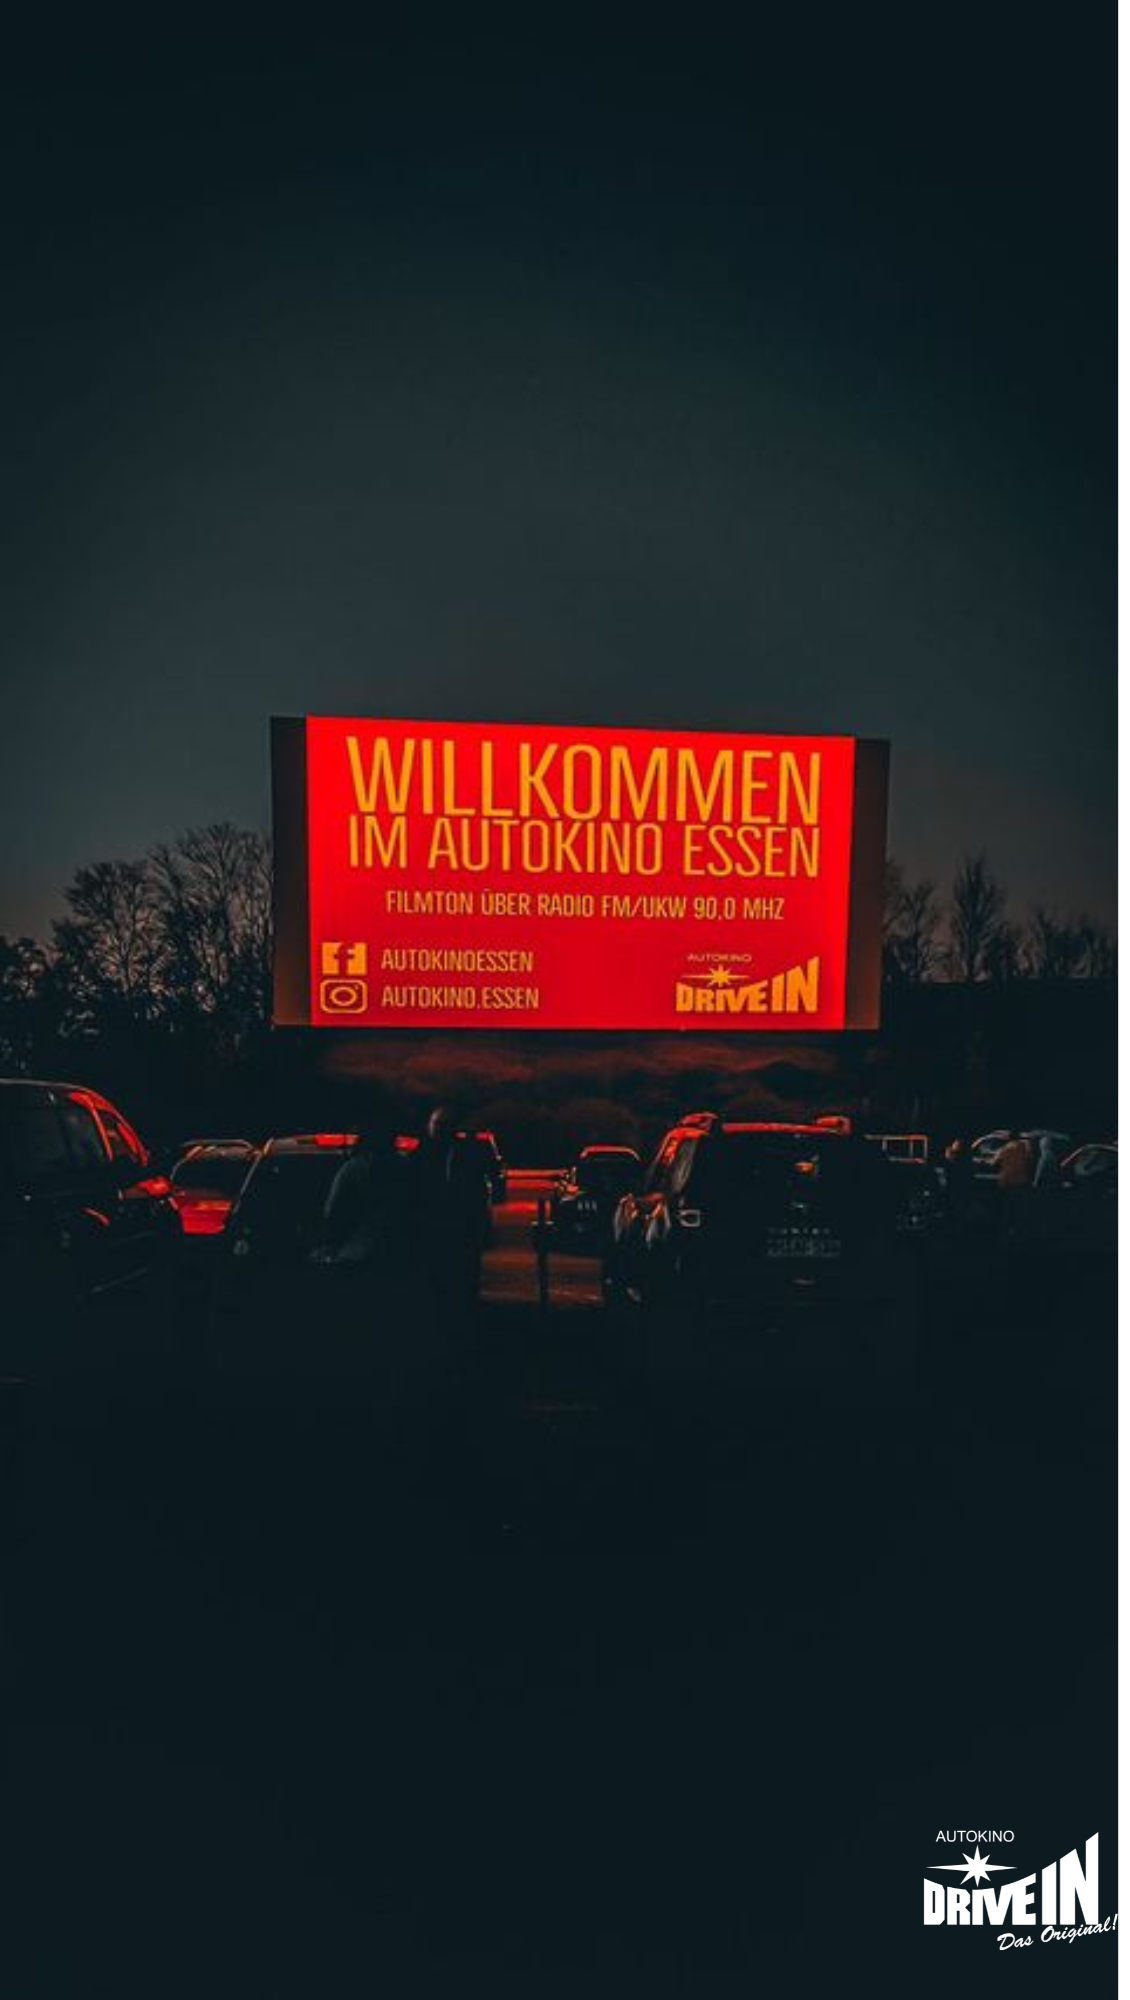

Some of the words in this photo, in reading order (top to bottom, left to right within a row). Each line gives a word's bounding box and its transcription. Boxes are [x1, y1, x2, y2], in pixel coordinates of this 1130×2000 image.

[346, 736, 821, 826] WILLKOMMEN
[349, 815, 407, 869] IM
[428, 818, 663, 876] AUTOKINO
[683, 825, 820, 878] ESSEN
[386, 890, 473, 914] FILMTON
[481, 888, 530, 916] ÜBER
[537, 893, 594, 917] RADIO
[602, 895, 686, 920] FM/UKW
[694, 897, 735, 921] 90.0
[743, 898, 784, 920] MHZ
[381, 948, 533, 972] AUTOKINOESSEN
[687, 953, 752, 963] AUTOKINO
[381, 985, 539, 1009] AUTOKINO.ESSEN
